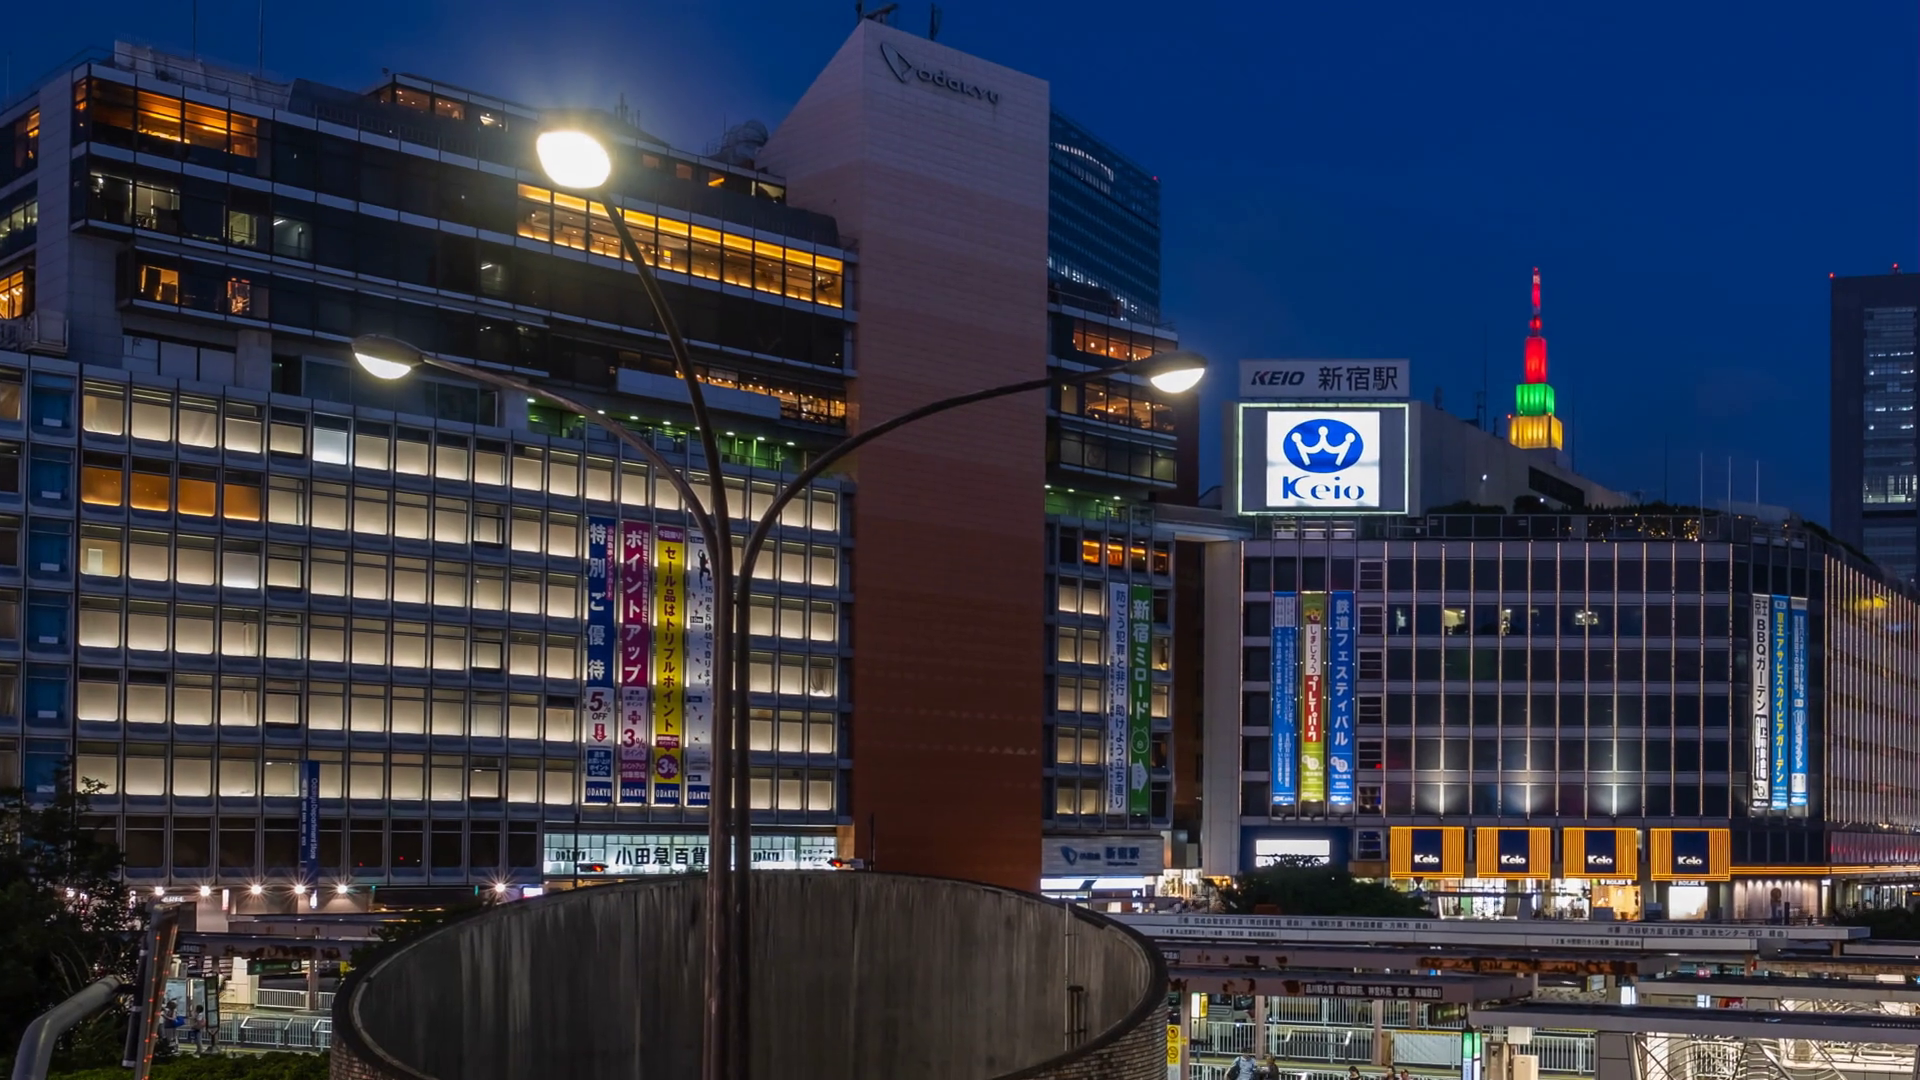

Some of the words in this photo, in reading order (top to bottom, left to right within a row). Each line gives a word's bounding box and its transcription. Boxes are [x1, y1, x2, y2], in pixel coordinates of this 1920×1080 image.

[916, 69, 1000, 105] odakyu
[1251, 371, 1305, 386] KEIO
[1318, 366, 1398, 391] 新宿駅
[1283, 475, 1365, 500] Keio
[588, 523, 606, 680] 特別ご優待
[624, 530, 642, 682] ポイントアップ
[663, 546, 676, 732] セール品はトリプルポイント
[1133, 599, 1149, 720] 新宿ミロード
[1756, 619, 1766, 711] BBQガーデン
[1335, 599, 1349, 746] 鉄道フェスティバル
[589, 691, 611, 713] 5%
[623, 729, 645, 749] 3%
[658, 758, 678, 774] 3%
[586, 787, 611, 797] ODAKYU
[621, 788, 646, 797] ODAKYU
[656, 789, 679, 798] ODAKYU
[753, 850, 780, 862] ODAKYU
[1414, 854, 1439, 863] Keio
[1501, 855, 1526, 864] Keio
[1587, 855, 1613, 864] Keio
[1677, 856, 1702, 865] Keio
